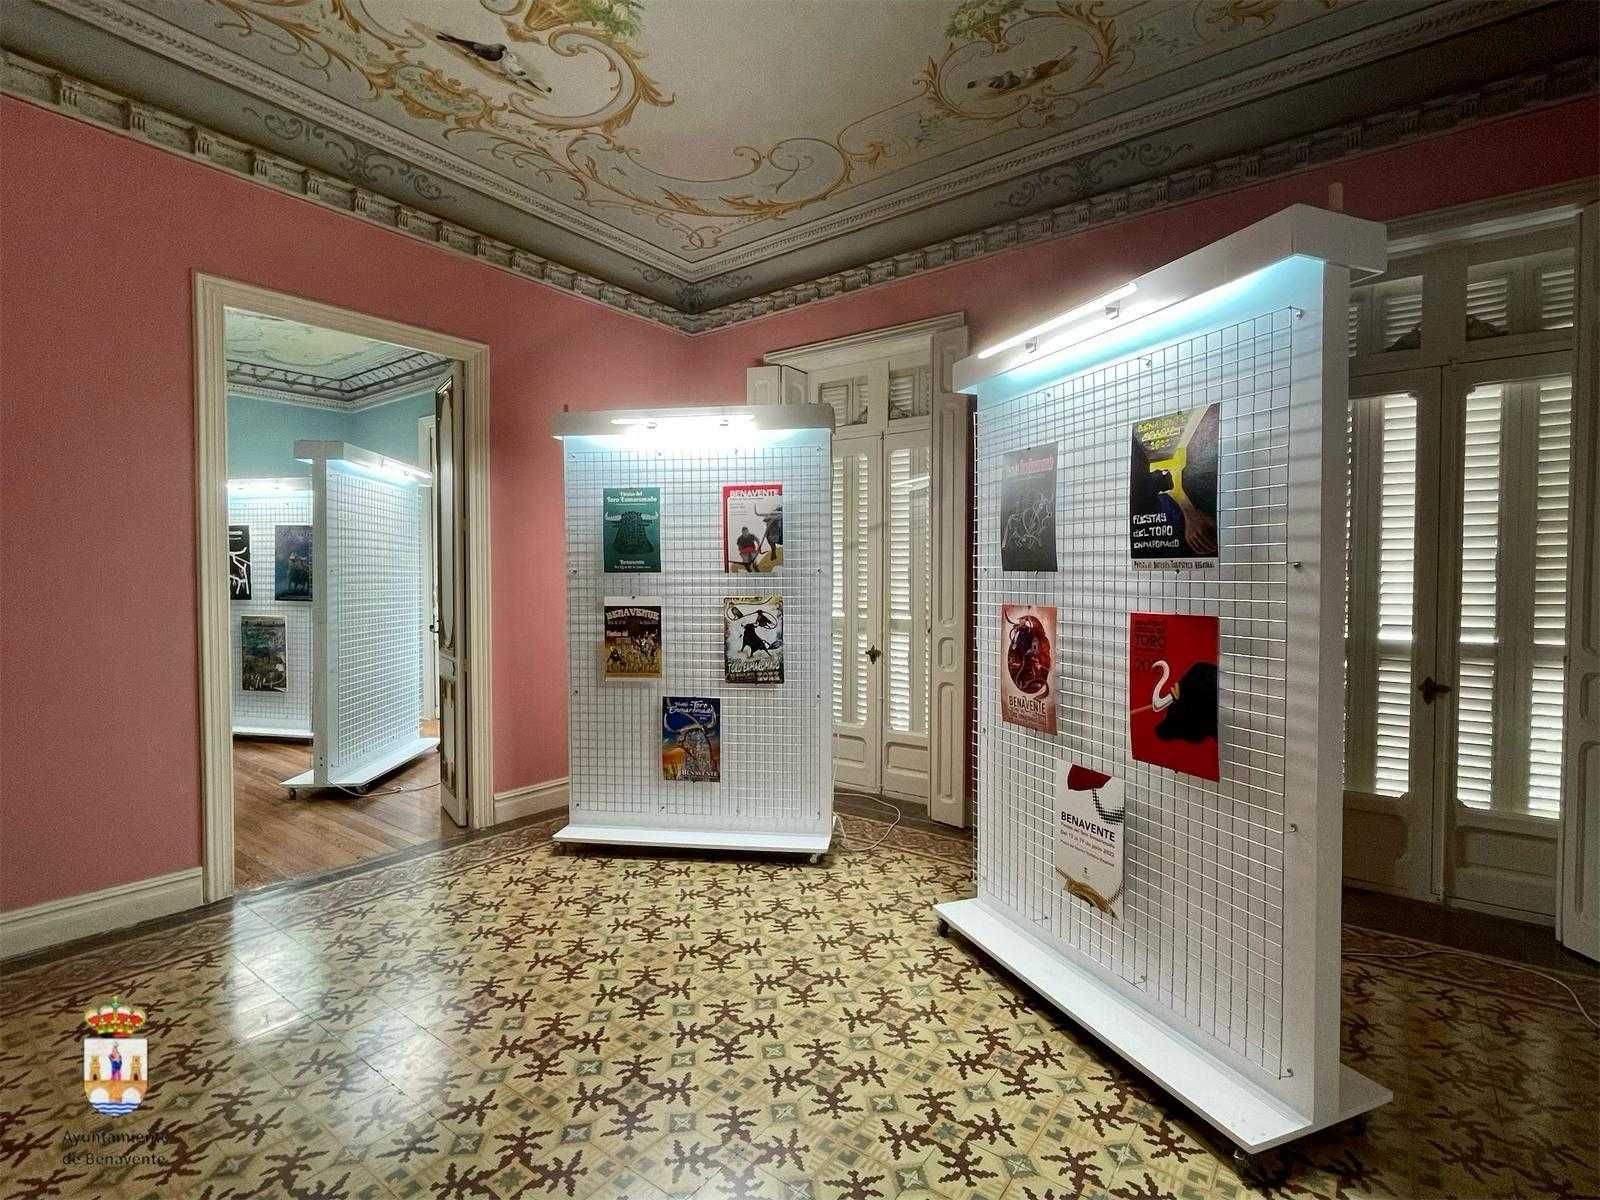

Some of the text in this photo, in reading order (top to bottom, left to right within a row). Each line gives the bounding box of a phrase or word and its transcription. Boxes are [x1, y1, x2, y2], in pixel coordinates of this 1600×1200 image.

[729, 489, 778, 497] BENAVENTE
[1132, 512, 1167, 525] FIESTAS
[1149, 525, 1173, 537] TORO
[606, 608, 660, 620] BENAVENTE
[1008, 695, 1046, 715] BENAVENTE
[1061, 811, 1115, 842] BENAVENTE
